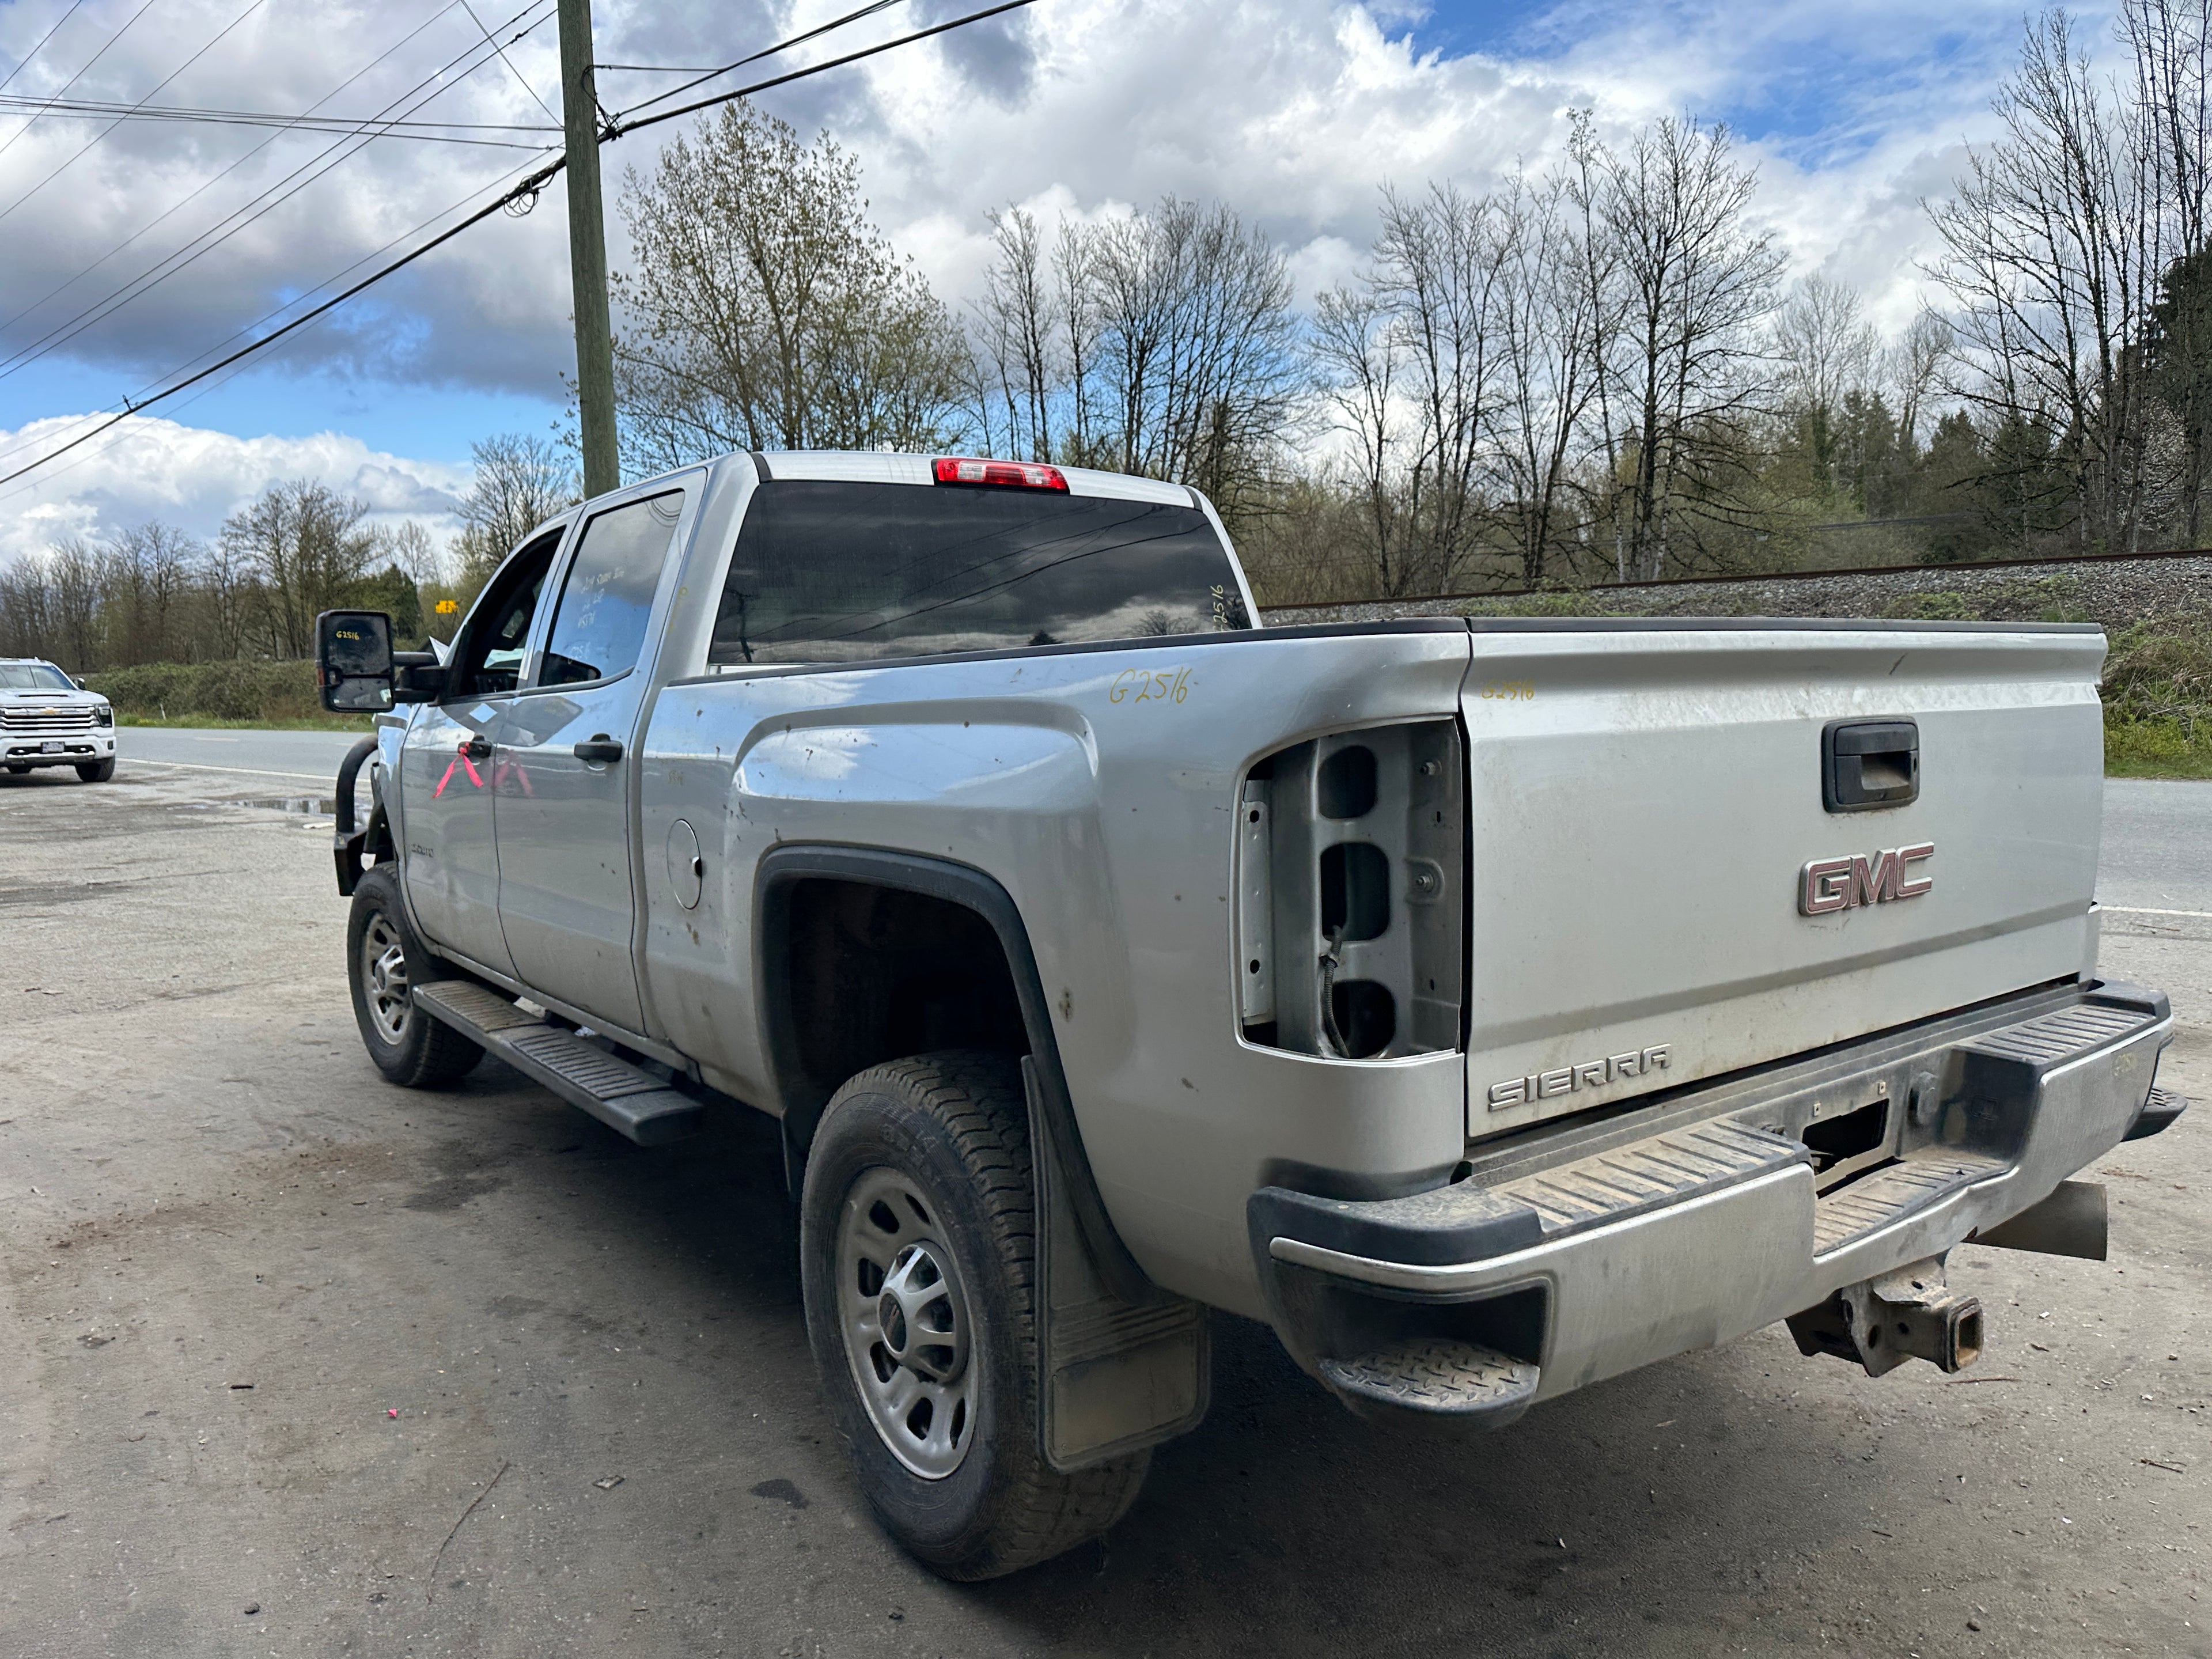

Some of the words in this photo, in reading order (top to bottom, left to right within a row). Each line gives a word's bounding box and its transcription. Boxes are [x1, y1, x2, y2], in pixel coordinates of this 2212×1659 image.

[336, 631, 359, 641] G2516
[1109, 666, 1192, 703] G2516
[1798, 841, 1934, 916] GMC
[1488, 1043, 1671, 1112] SIERRA
